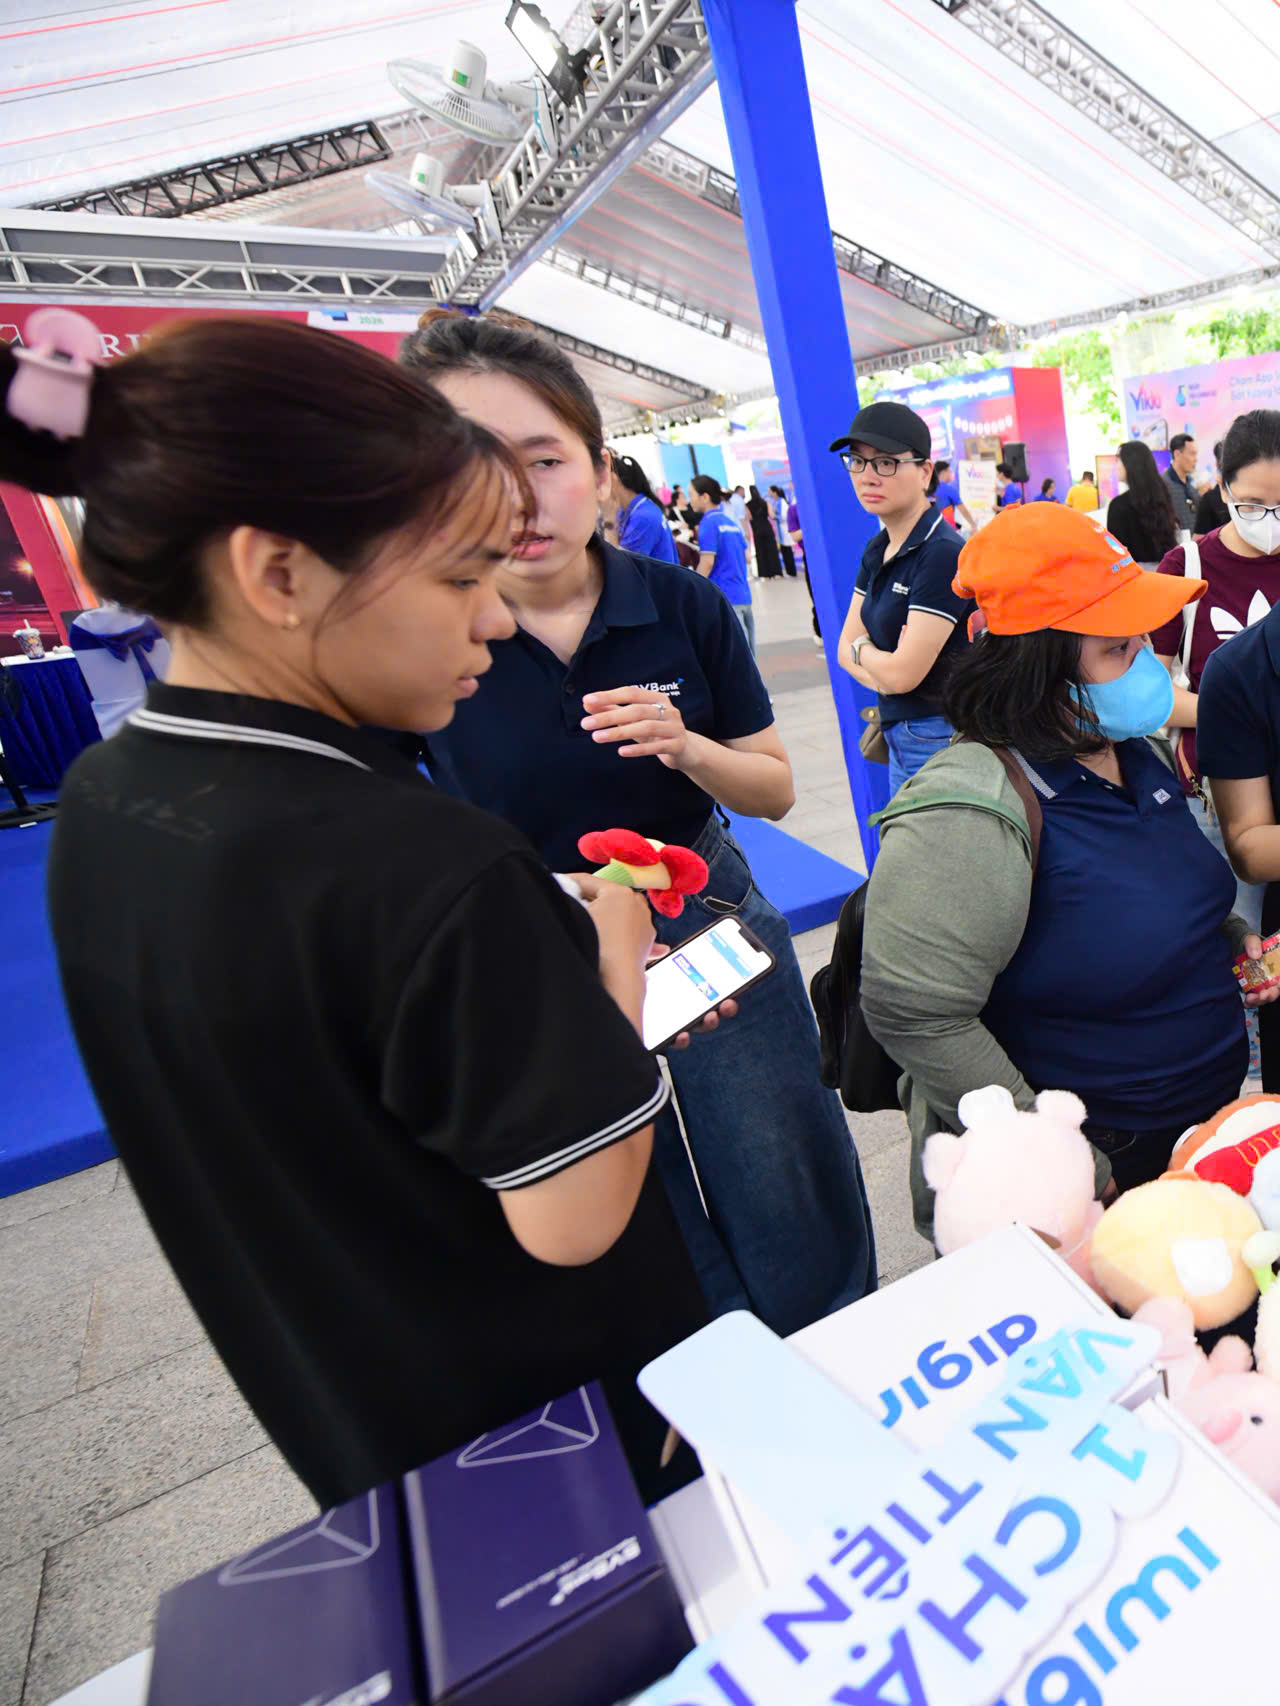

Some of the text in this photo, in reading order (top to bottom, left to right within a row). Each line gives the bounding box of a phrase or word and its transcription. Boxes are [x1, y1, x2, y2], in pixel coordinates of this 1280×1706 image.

[637, 681, 679, 692] VBank
[762, 1327, 1134, 1664] VẠN TIỆN
[832, 1423, 1147, 1706] 1 CHẠ
[1024, 1526, 1221, 1706] gimi
